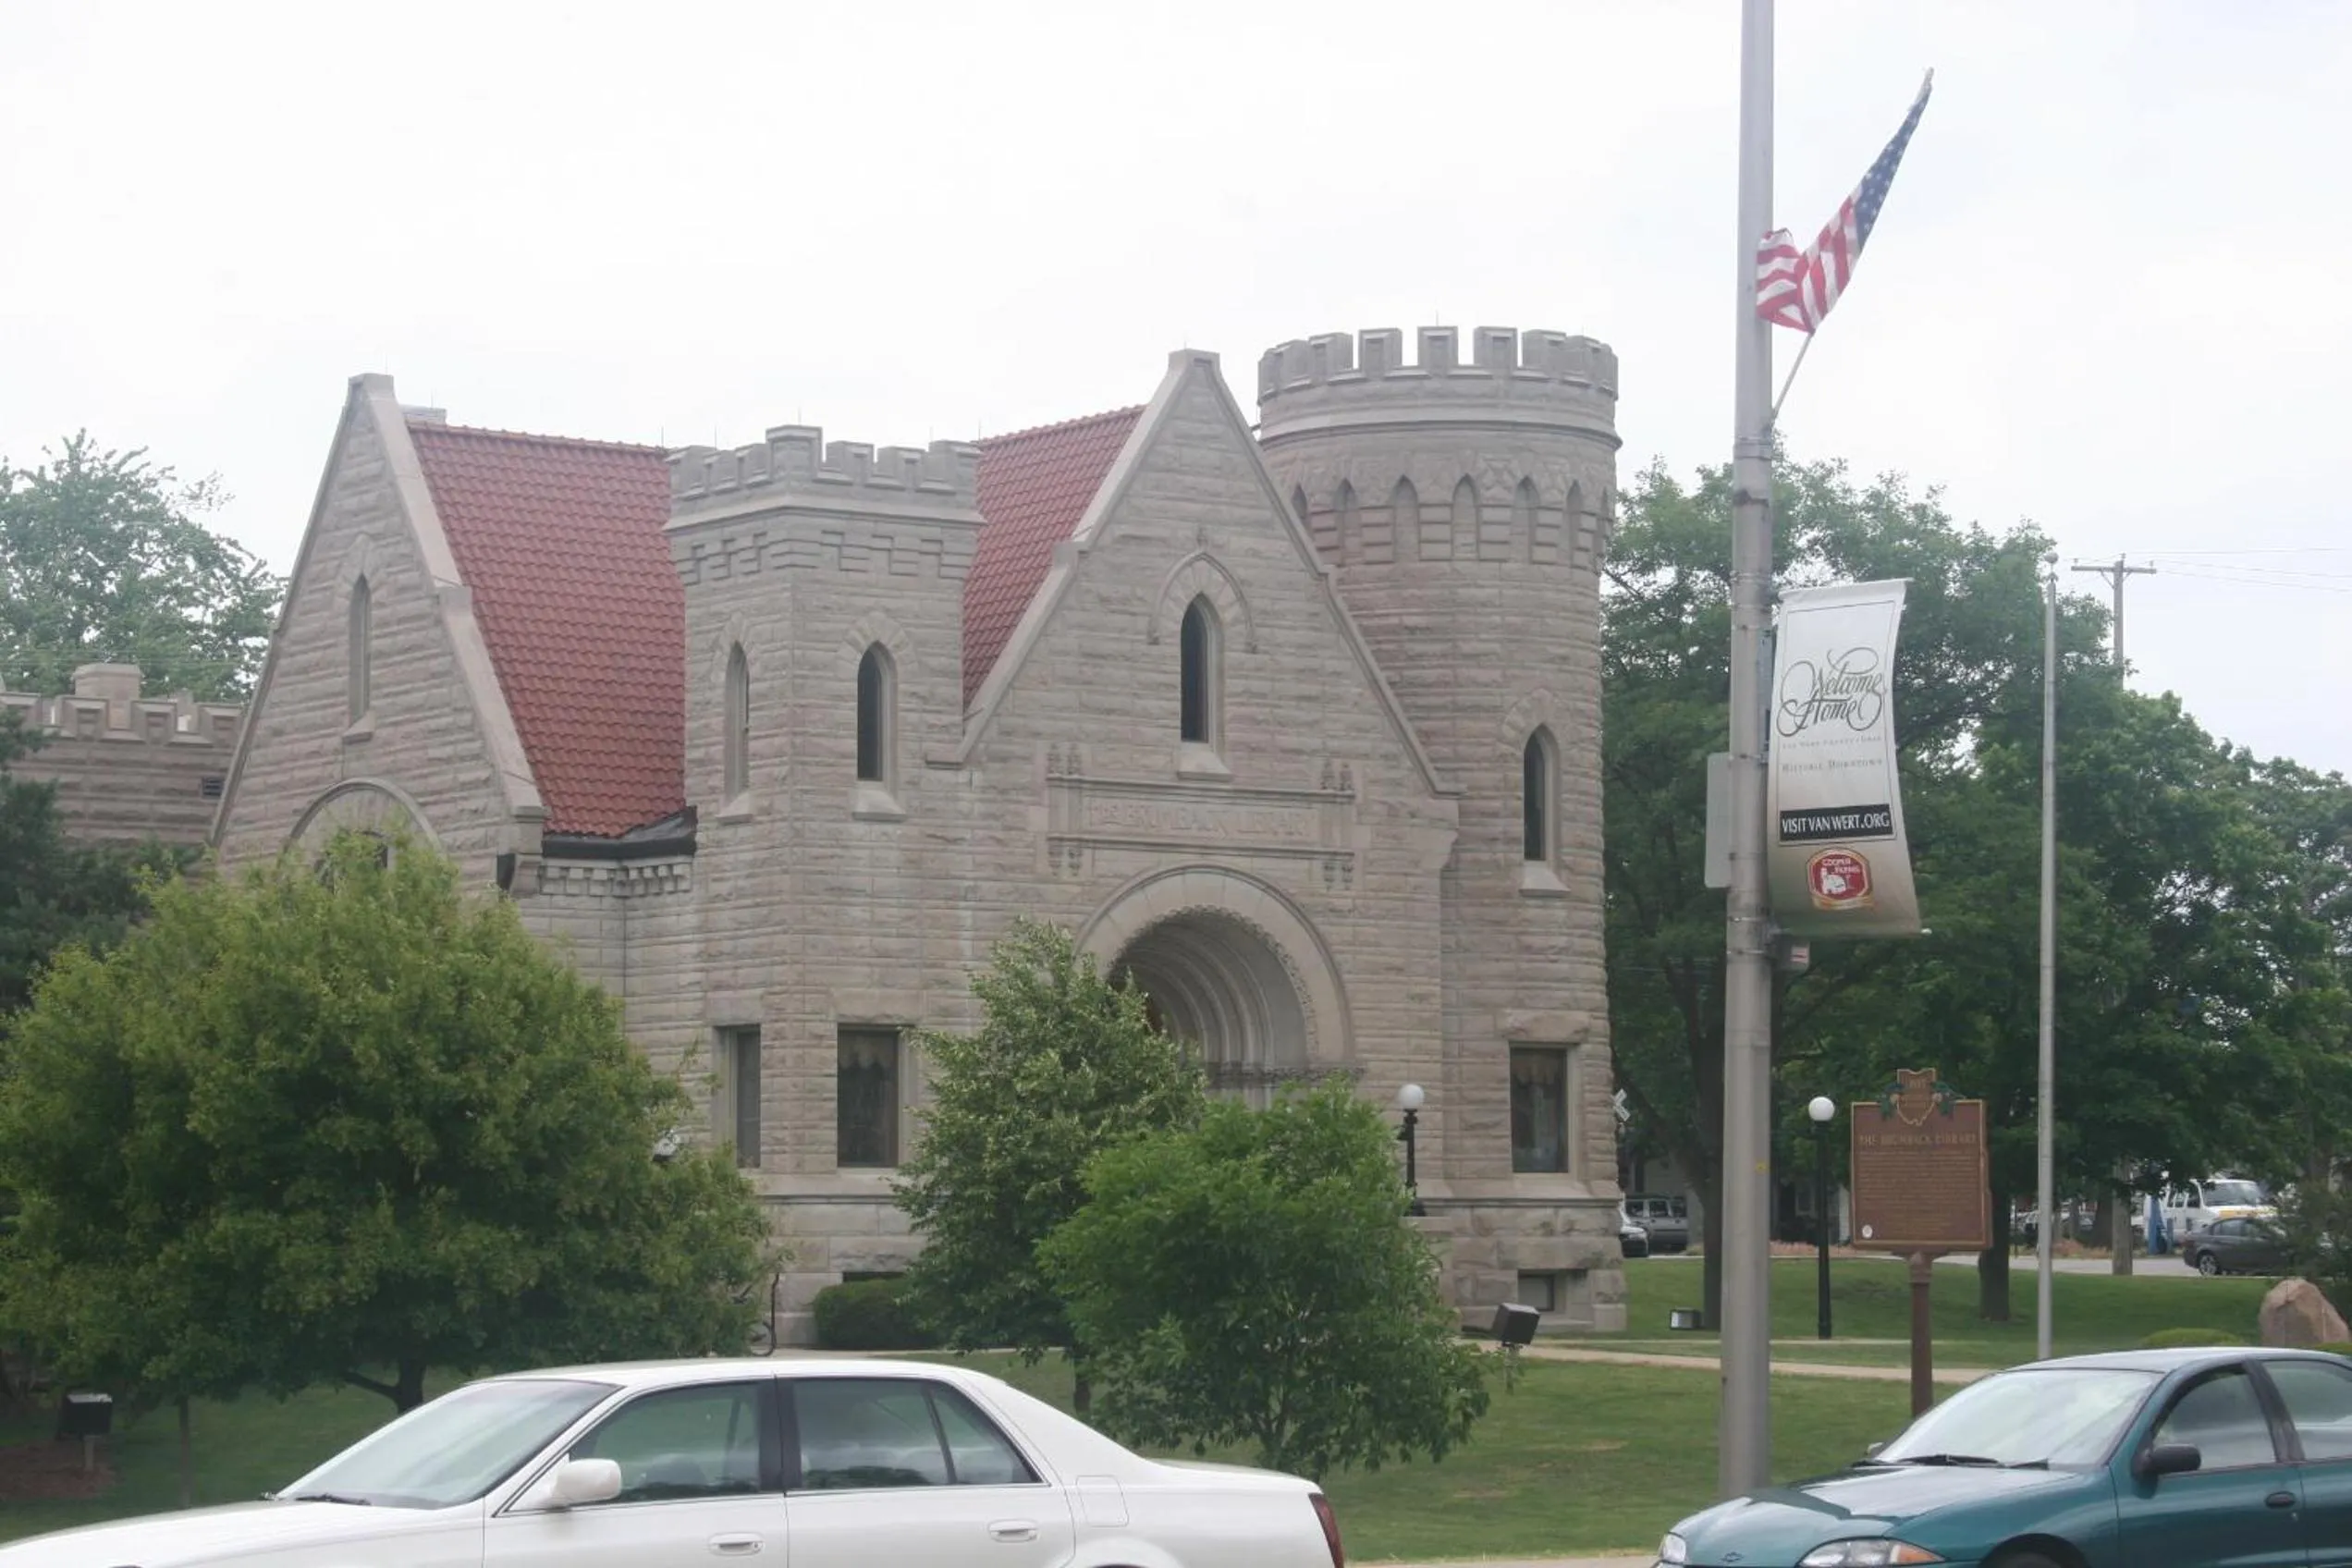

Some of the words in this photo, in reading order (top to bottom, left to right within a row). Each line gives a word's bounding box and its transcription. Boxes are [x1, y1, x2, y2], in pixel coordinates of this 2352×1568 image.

[1782, 816, 1807, 833] VISIT
[1807, 815, 1831, 832] VAN
[1831, 812, 1891, 831] WERT.ORG
